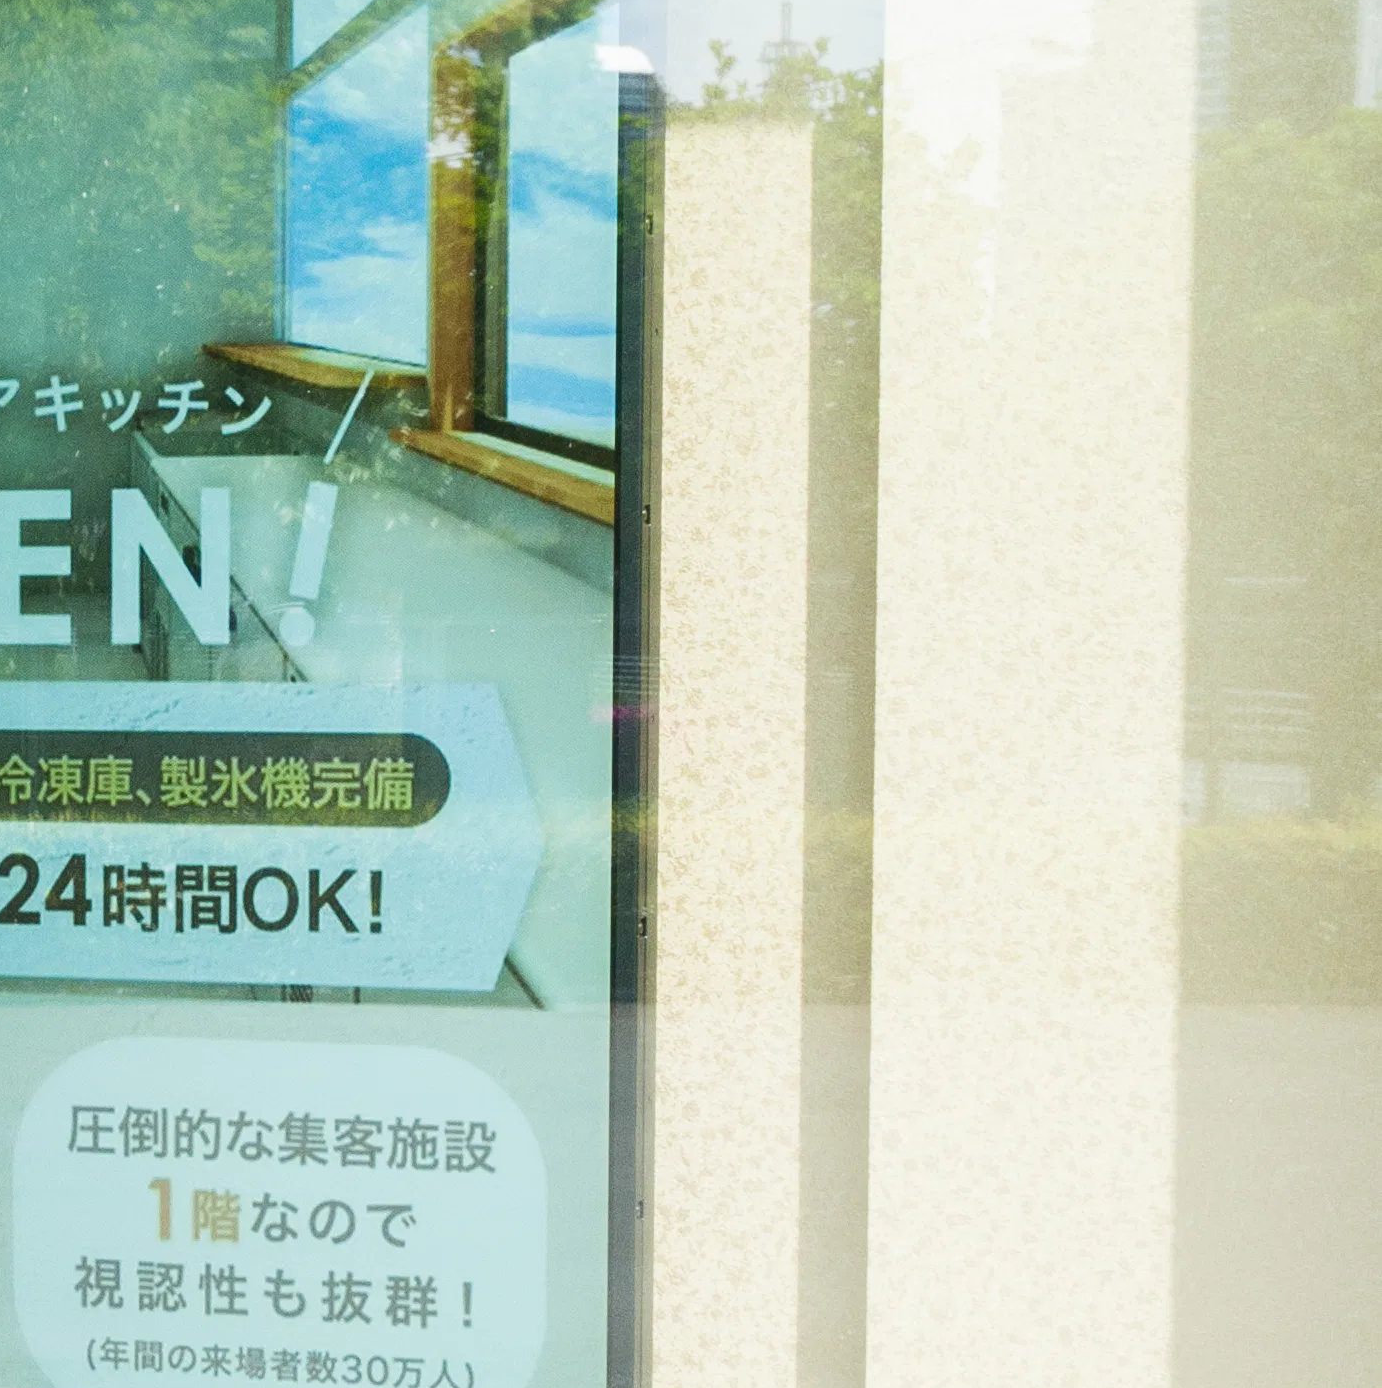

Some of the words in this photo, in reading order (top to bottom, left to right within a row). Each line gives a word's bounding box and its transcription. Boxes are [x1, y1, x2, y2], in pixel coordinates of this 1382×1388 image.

[68, 1105, 498, 1175] 圧倒的な集客施設
[148, 1177, 418, 1249] 1階なので
